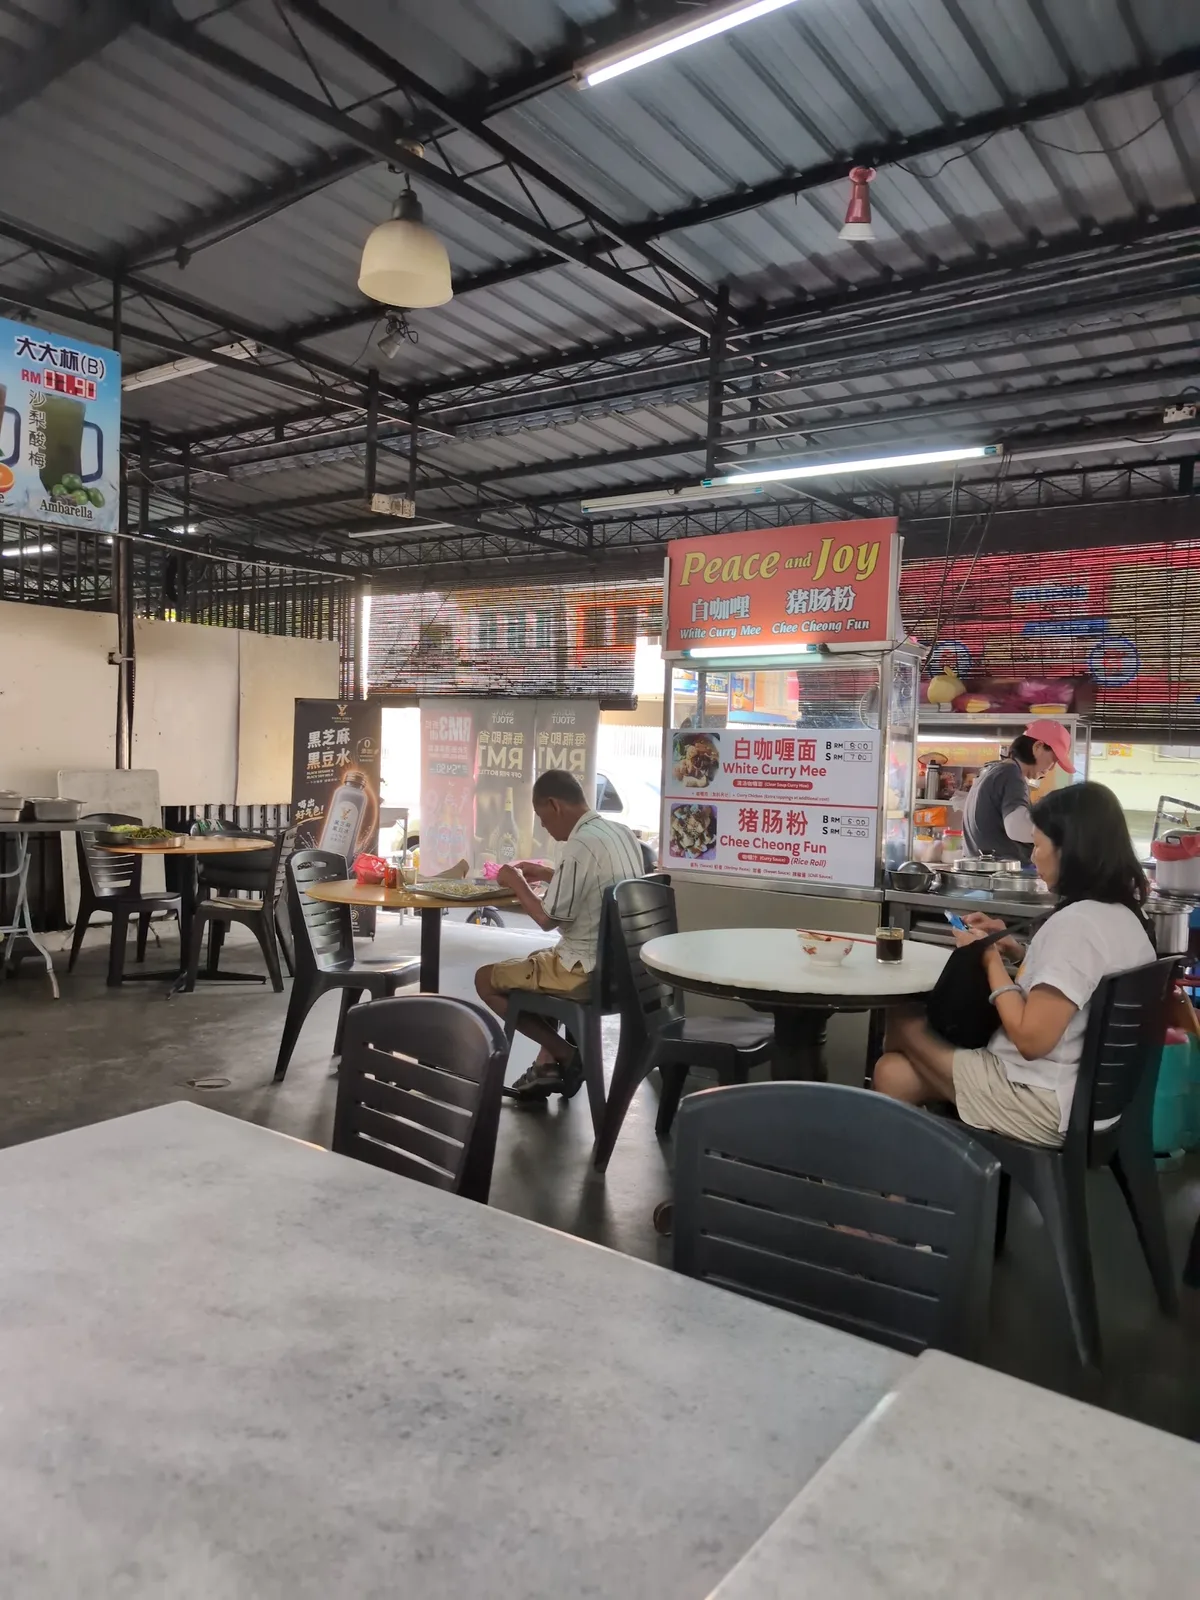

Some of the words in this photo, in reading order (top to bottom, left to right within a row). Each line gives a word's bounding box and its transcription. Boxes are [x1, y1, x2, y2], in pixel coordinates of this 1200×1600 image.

[21, 369, 41, 384] RM
[28, 389, 47, 469] 沙梨酸梅
[40, 499, 93, 520] Ambarella
[679, 551, 781, 586] Peace
[784, 553, 812, 569] and
[812, 537, 881, 582] Joy
[785, 585, 856, 615] 猪肠粉
[680, 627, 706, 640] White
[708, 626, 737, 640] Curry
[740, 625, 762, 636] Mee
[771, 622, 798, 635] Chee
[801, 620, 842, 634] Cheong
[846, 619, 870, 630] Fun
[307, 727, 351, 749] 黑芝麻
[825, 741, 832, 750] B
[306, 748, 351, 770] 黑豆水
[734, 737, 818, 763] 白咖喱面
[825, 753, 832, 761] S
[722, 762, 759, 775] White
[761, 764, 797, 779] Curry
[799, 765, 827, 777] Mee
[295, 804, 325, 820] 好气色!
[297, 798, 315, 809] 喝出
[738, 807, 808, 836] 猪肠粉
[822, 815, 829, 824] B
[822, 826, 828, 835] S
[720, 835, 750, 848] Chee
[752, 837, 801, 857] Cheong
[803, 840, 827, 854] Fun
[790, 856, 808, 866] (Rice
[809, 858, 827, 868] Roll)
